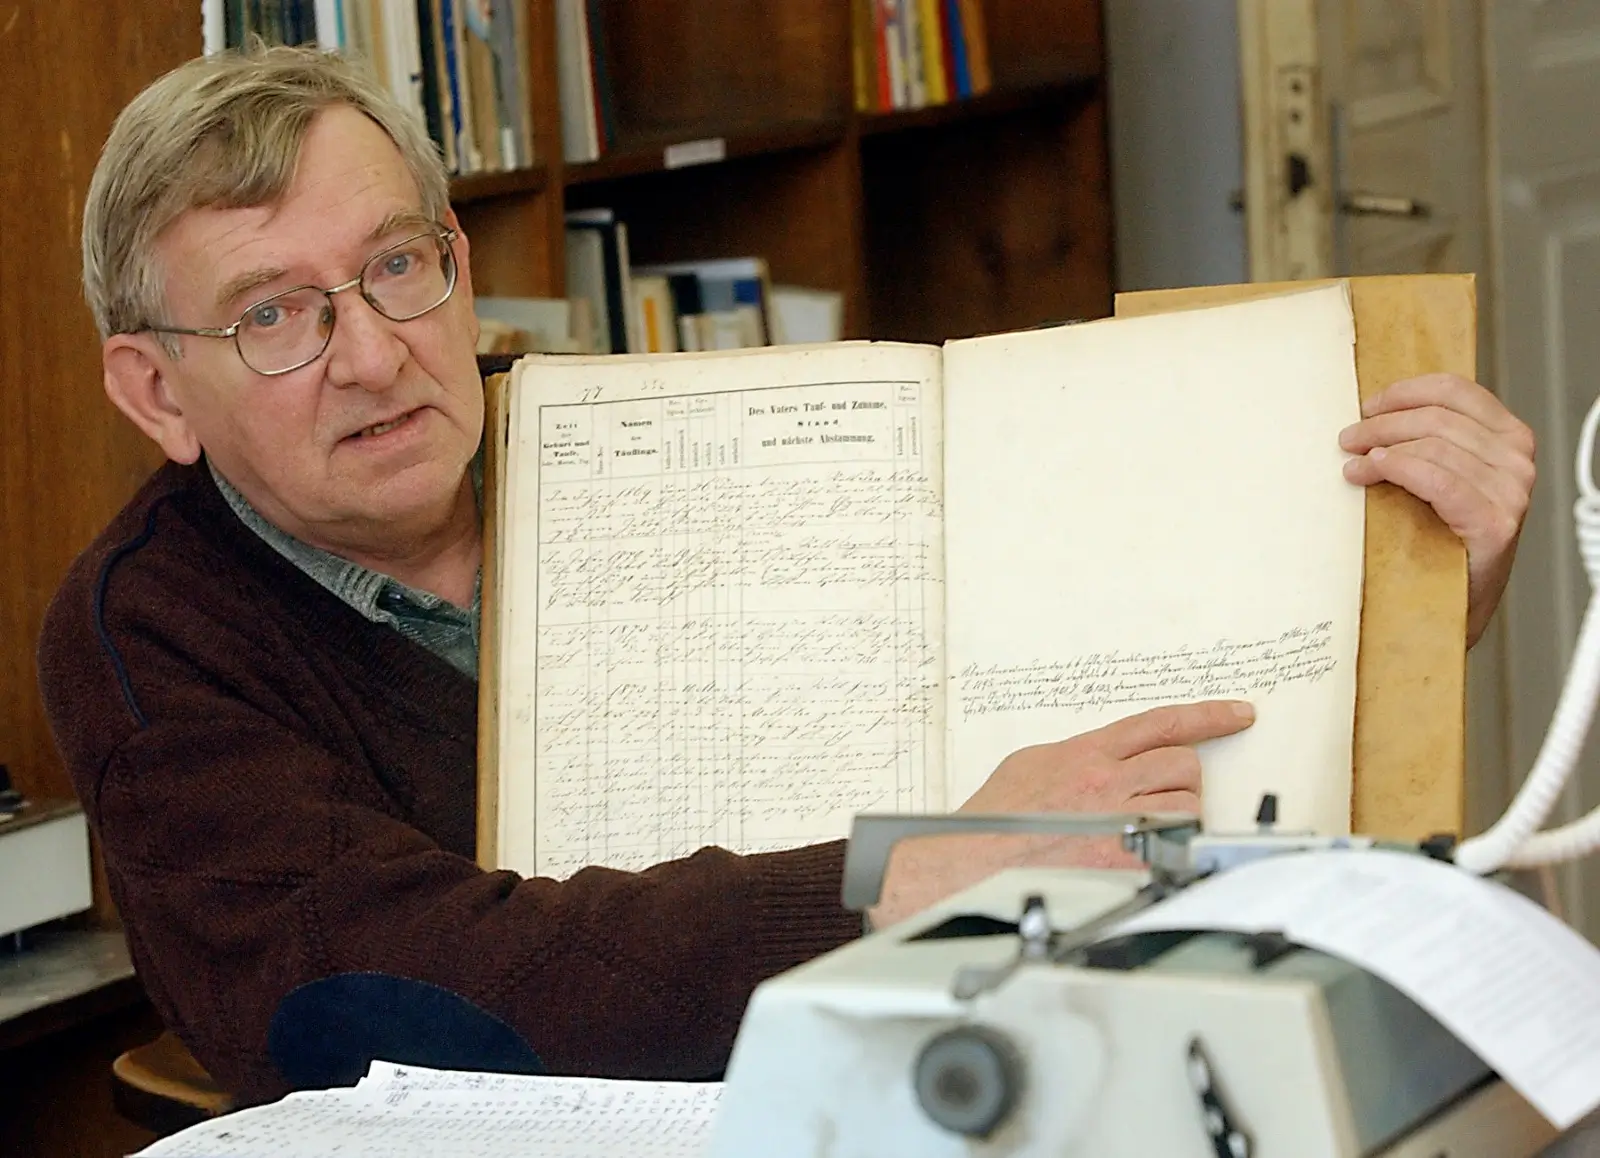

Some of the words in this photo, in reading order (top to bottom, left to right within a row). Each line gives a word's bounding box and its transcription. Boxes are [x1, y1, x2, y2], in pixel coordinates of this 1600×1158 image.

[749, 407, 765, 416] Des
[770, 404, 798, 414] Vaters
[803, 402, 827, 412] Tauf-
[831, 401, 847, 410] und
[761, 438, 776, 447] und
[781, 436, 814, 446] nächste
